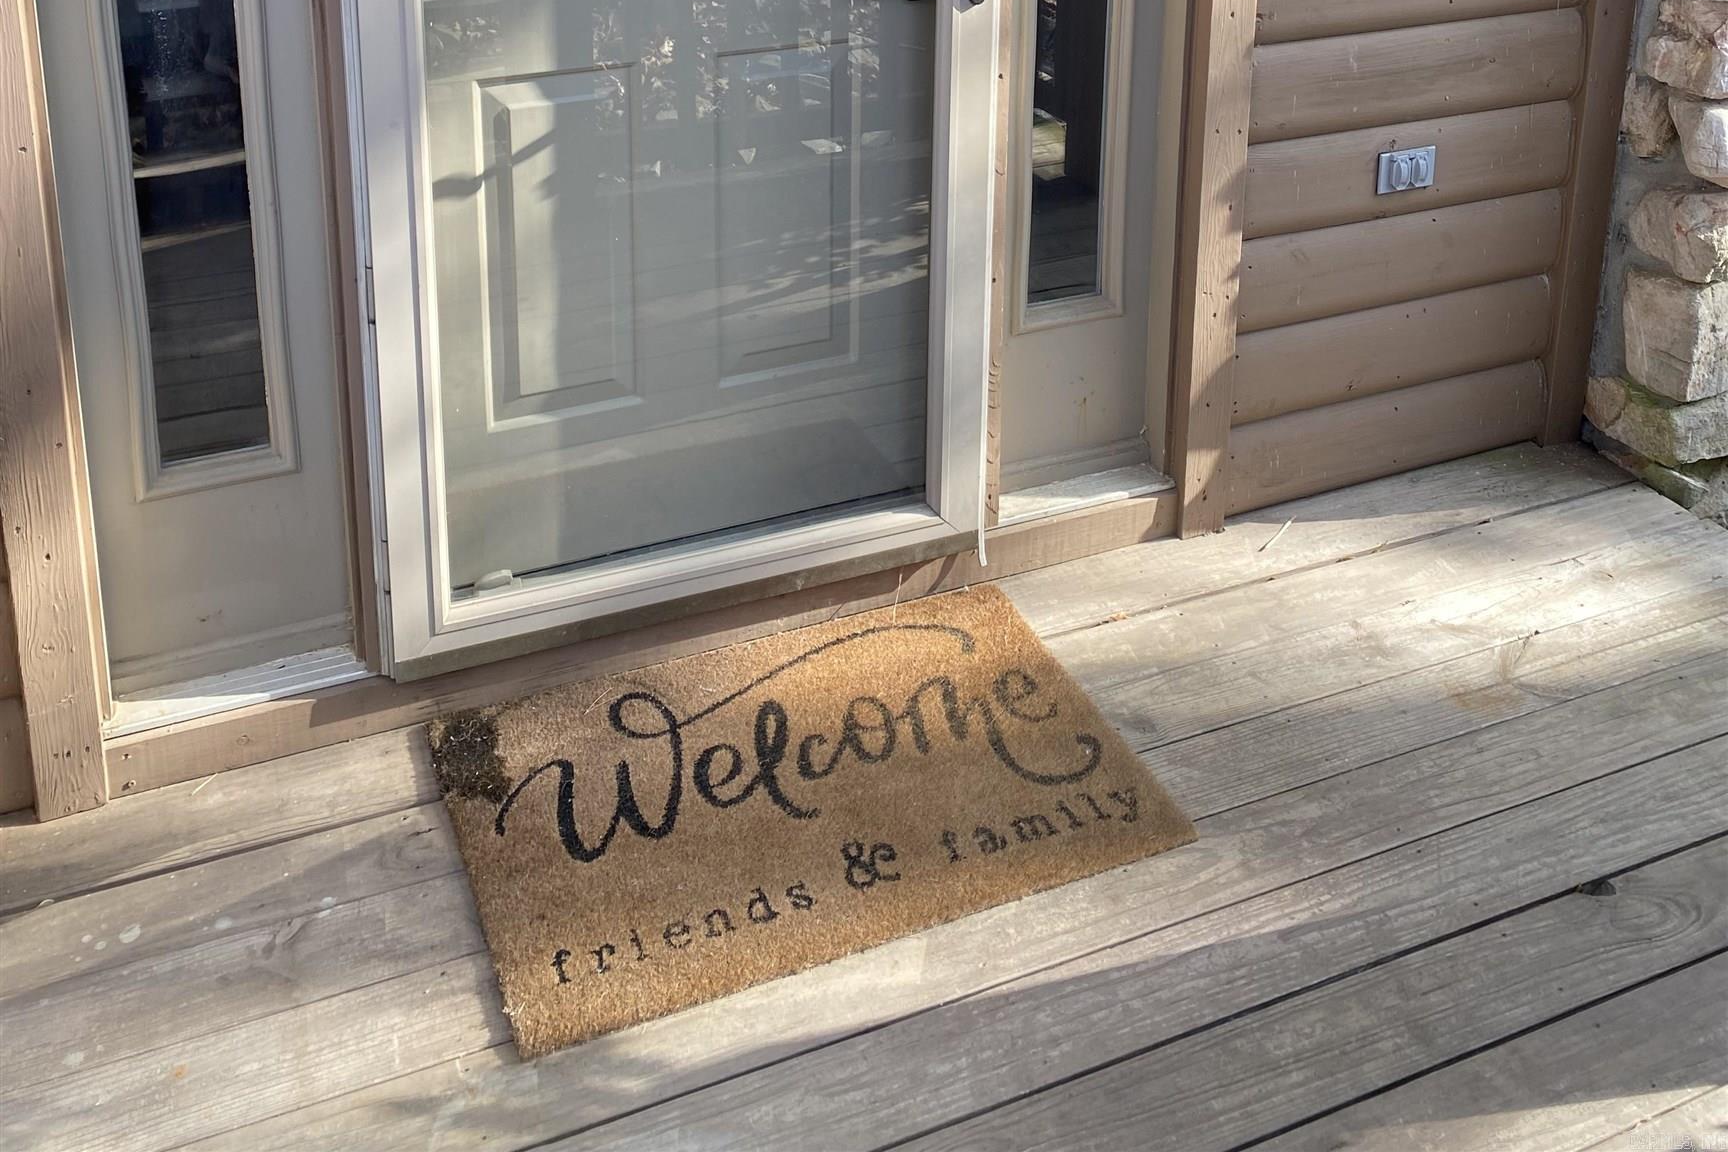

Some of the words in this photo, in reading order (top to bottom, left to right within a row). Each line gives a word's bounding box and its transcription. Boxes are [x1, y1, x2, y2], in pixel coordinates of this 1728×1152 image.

[496, 624, 1100, 862] Welcome
[551, 880, 816, 985] friends
[842, 839, 900, 892] &
[942, 786, 1138, 864] family
